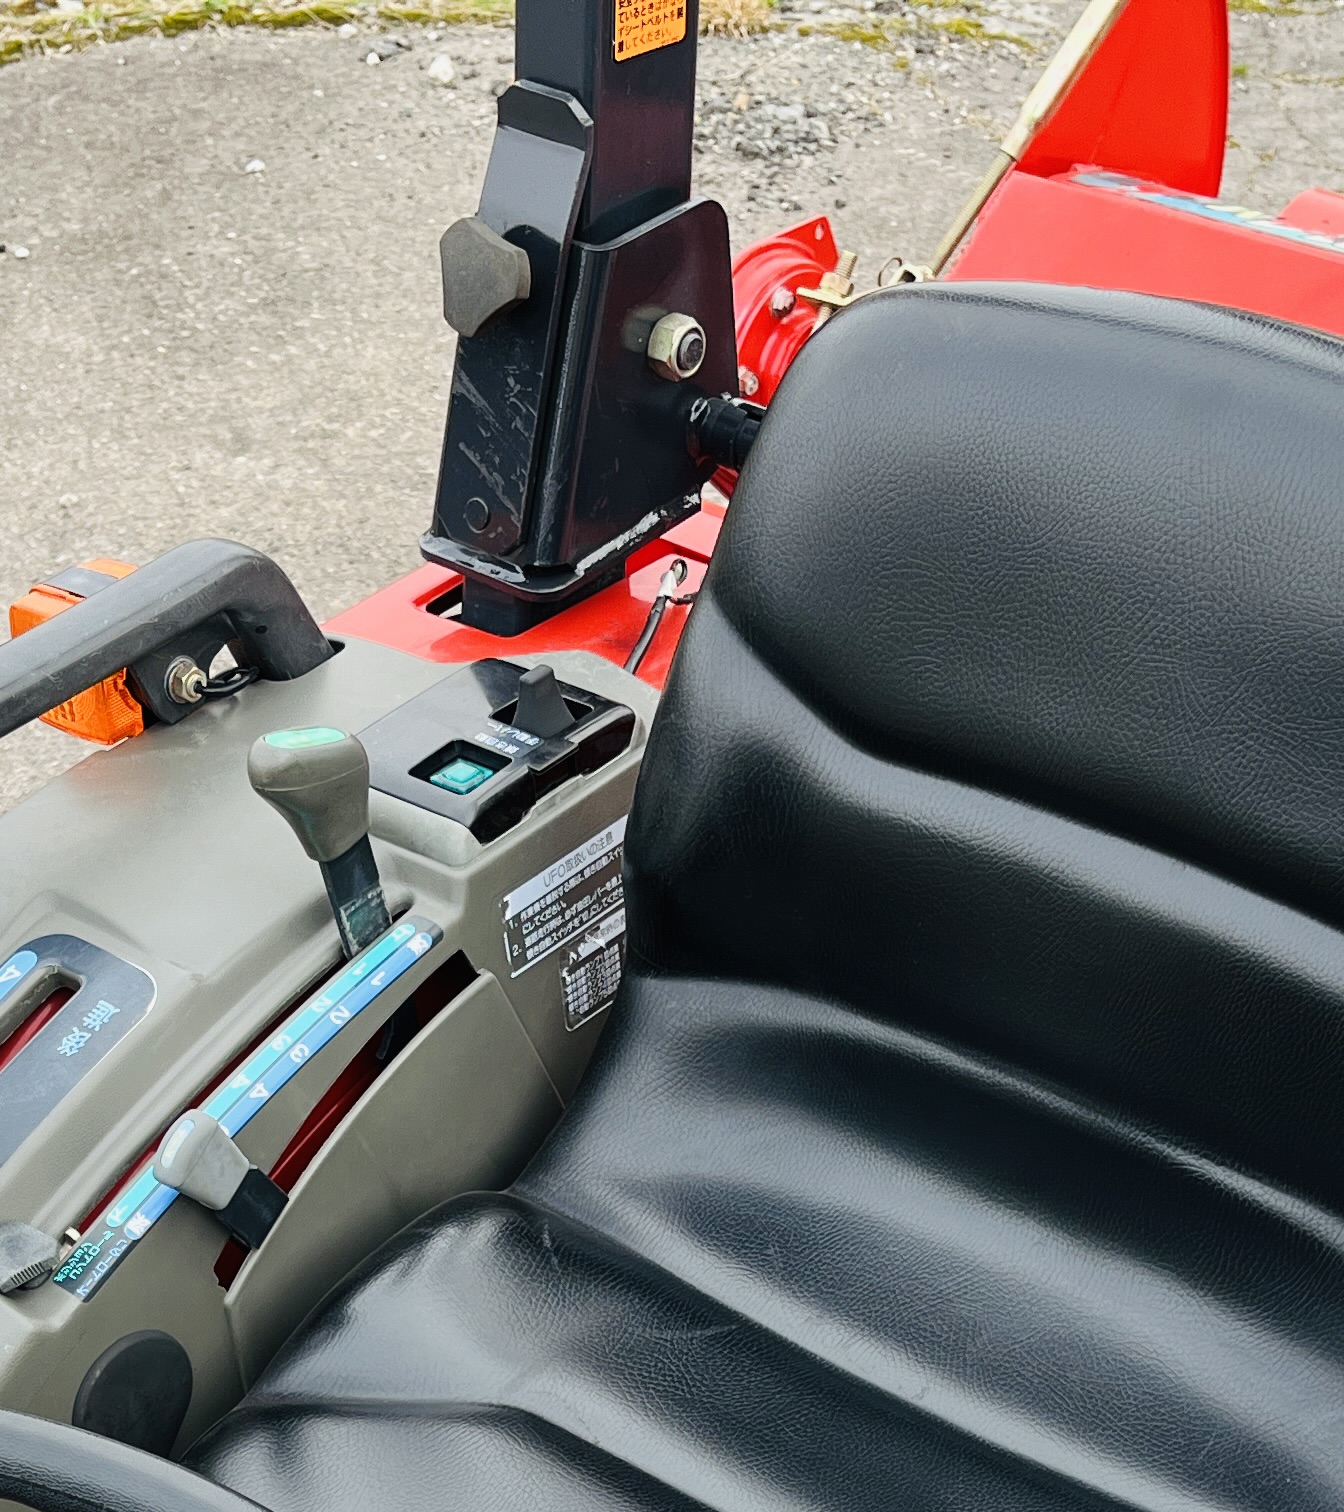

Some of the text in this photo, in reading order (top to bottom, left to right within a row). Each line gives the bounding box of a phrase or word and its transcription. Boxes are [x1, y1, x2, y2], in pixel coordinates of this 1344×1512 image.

[370, 970, 387, 986] 1
[311, 996, 333, 1013] 2
[329, 1005, 352, 1026] 2
[56, 998, 122, 1058] 後進
[271, 1035, 292, 1052] 3
[290, 1044, 311, 1064] 3
[231, 1073, 251, 1090] 4
[248, 1083, 270, 1101] 4
